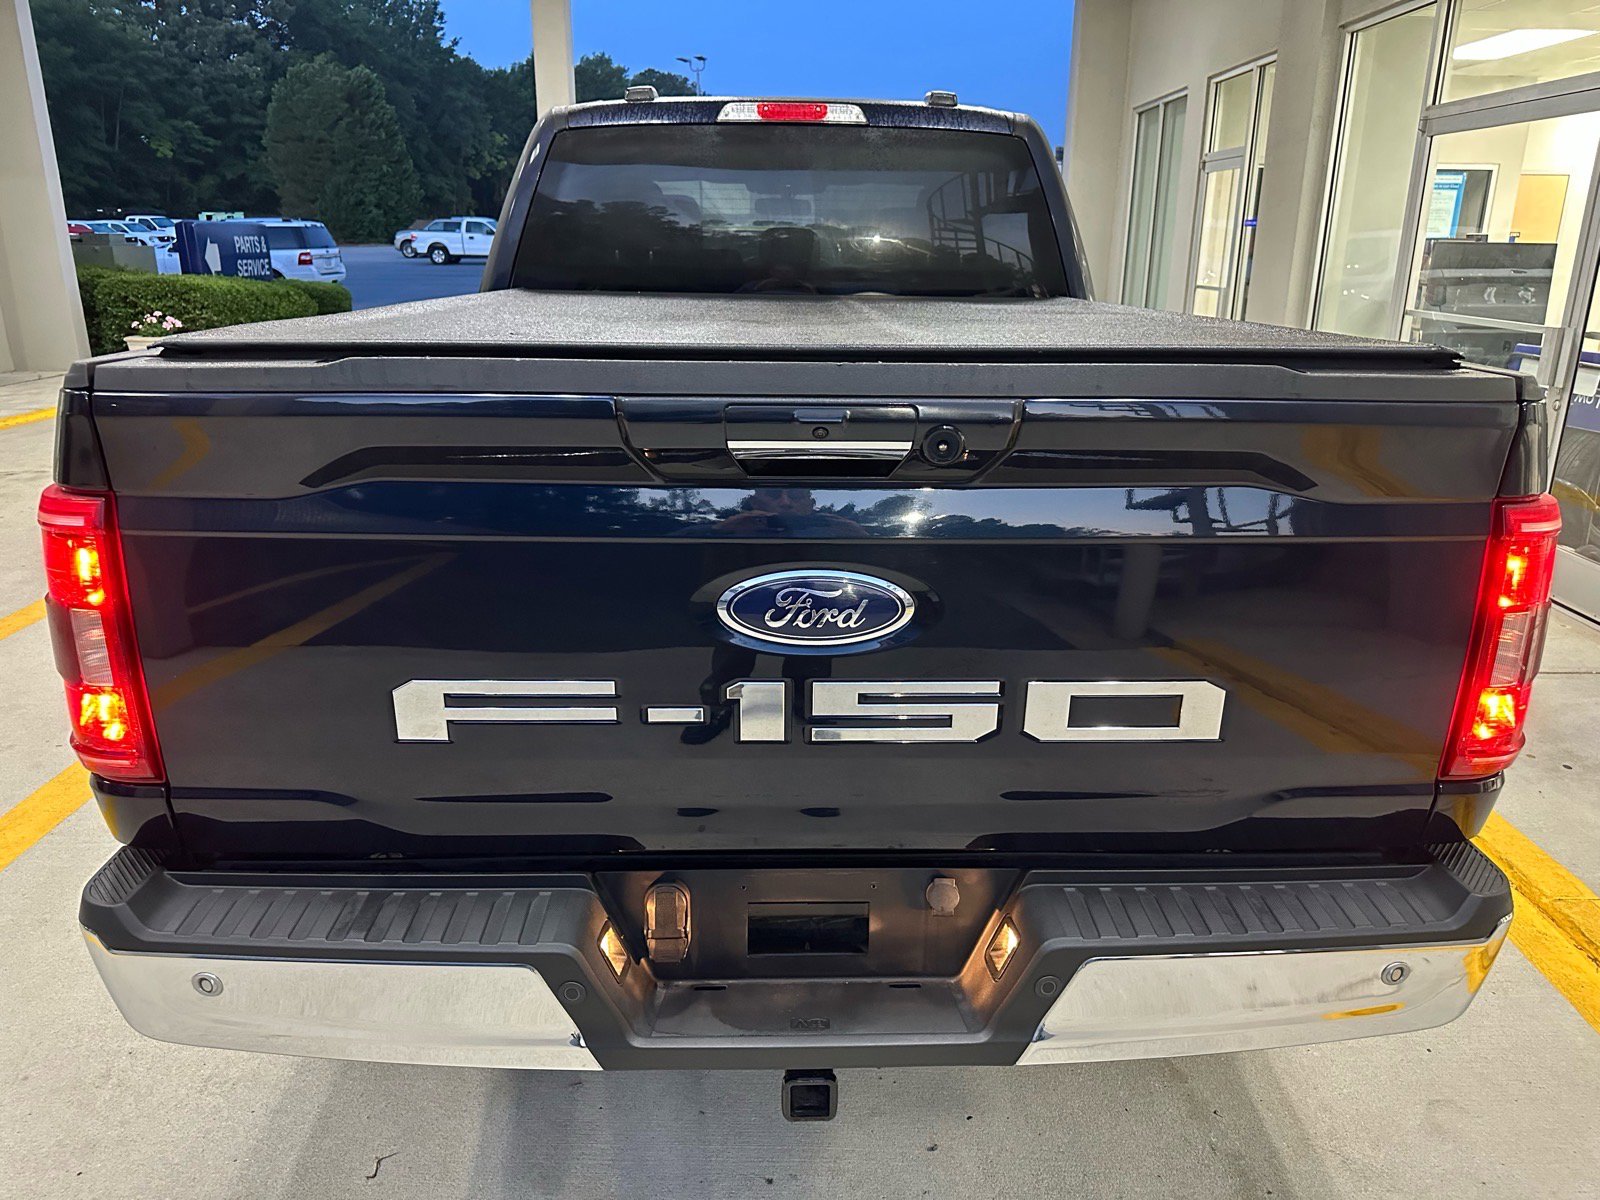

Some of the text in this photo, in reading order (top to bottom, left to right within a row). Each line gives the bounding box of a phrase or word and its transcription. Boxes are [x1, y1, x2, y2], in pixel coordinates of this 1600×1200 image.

[233, 235, 267, 253] PARTS &
[237, 258, 270, 277] SERVICE
[764, 587, 869, 629] Ford
[392, 679, 1226, 743] F-150
